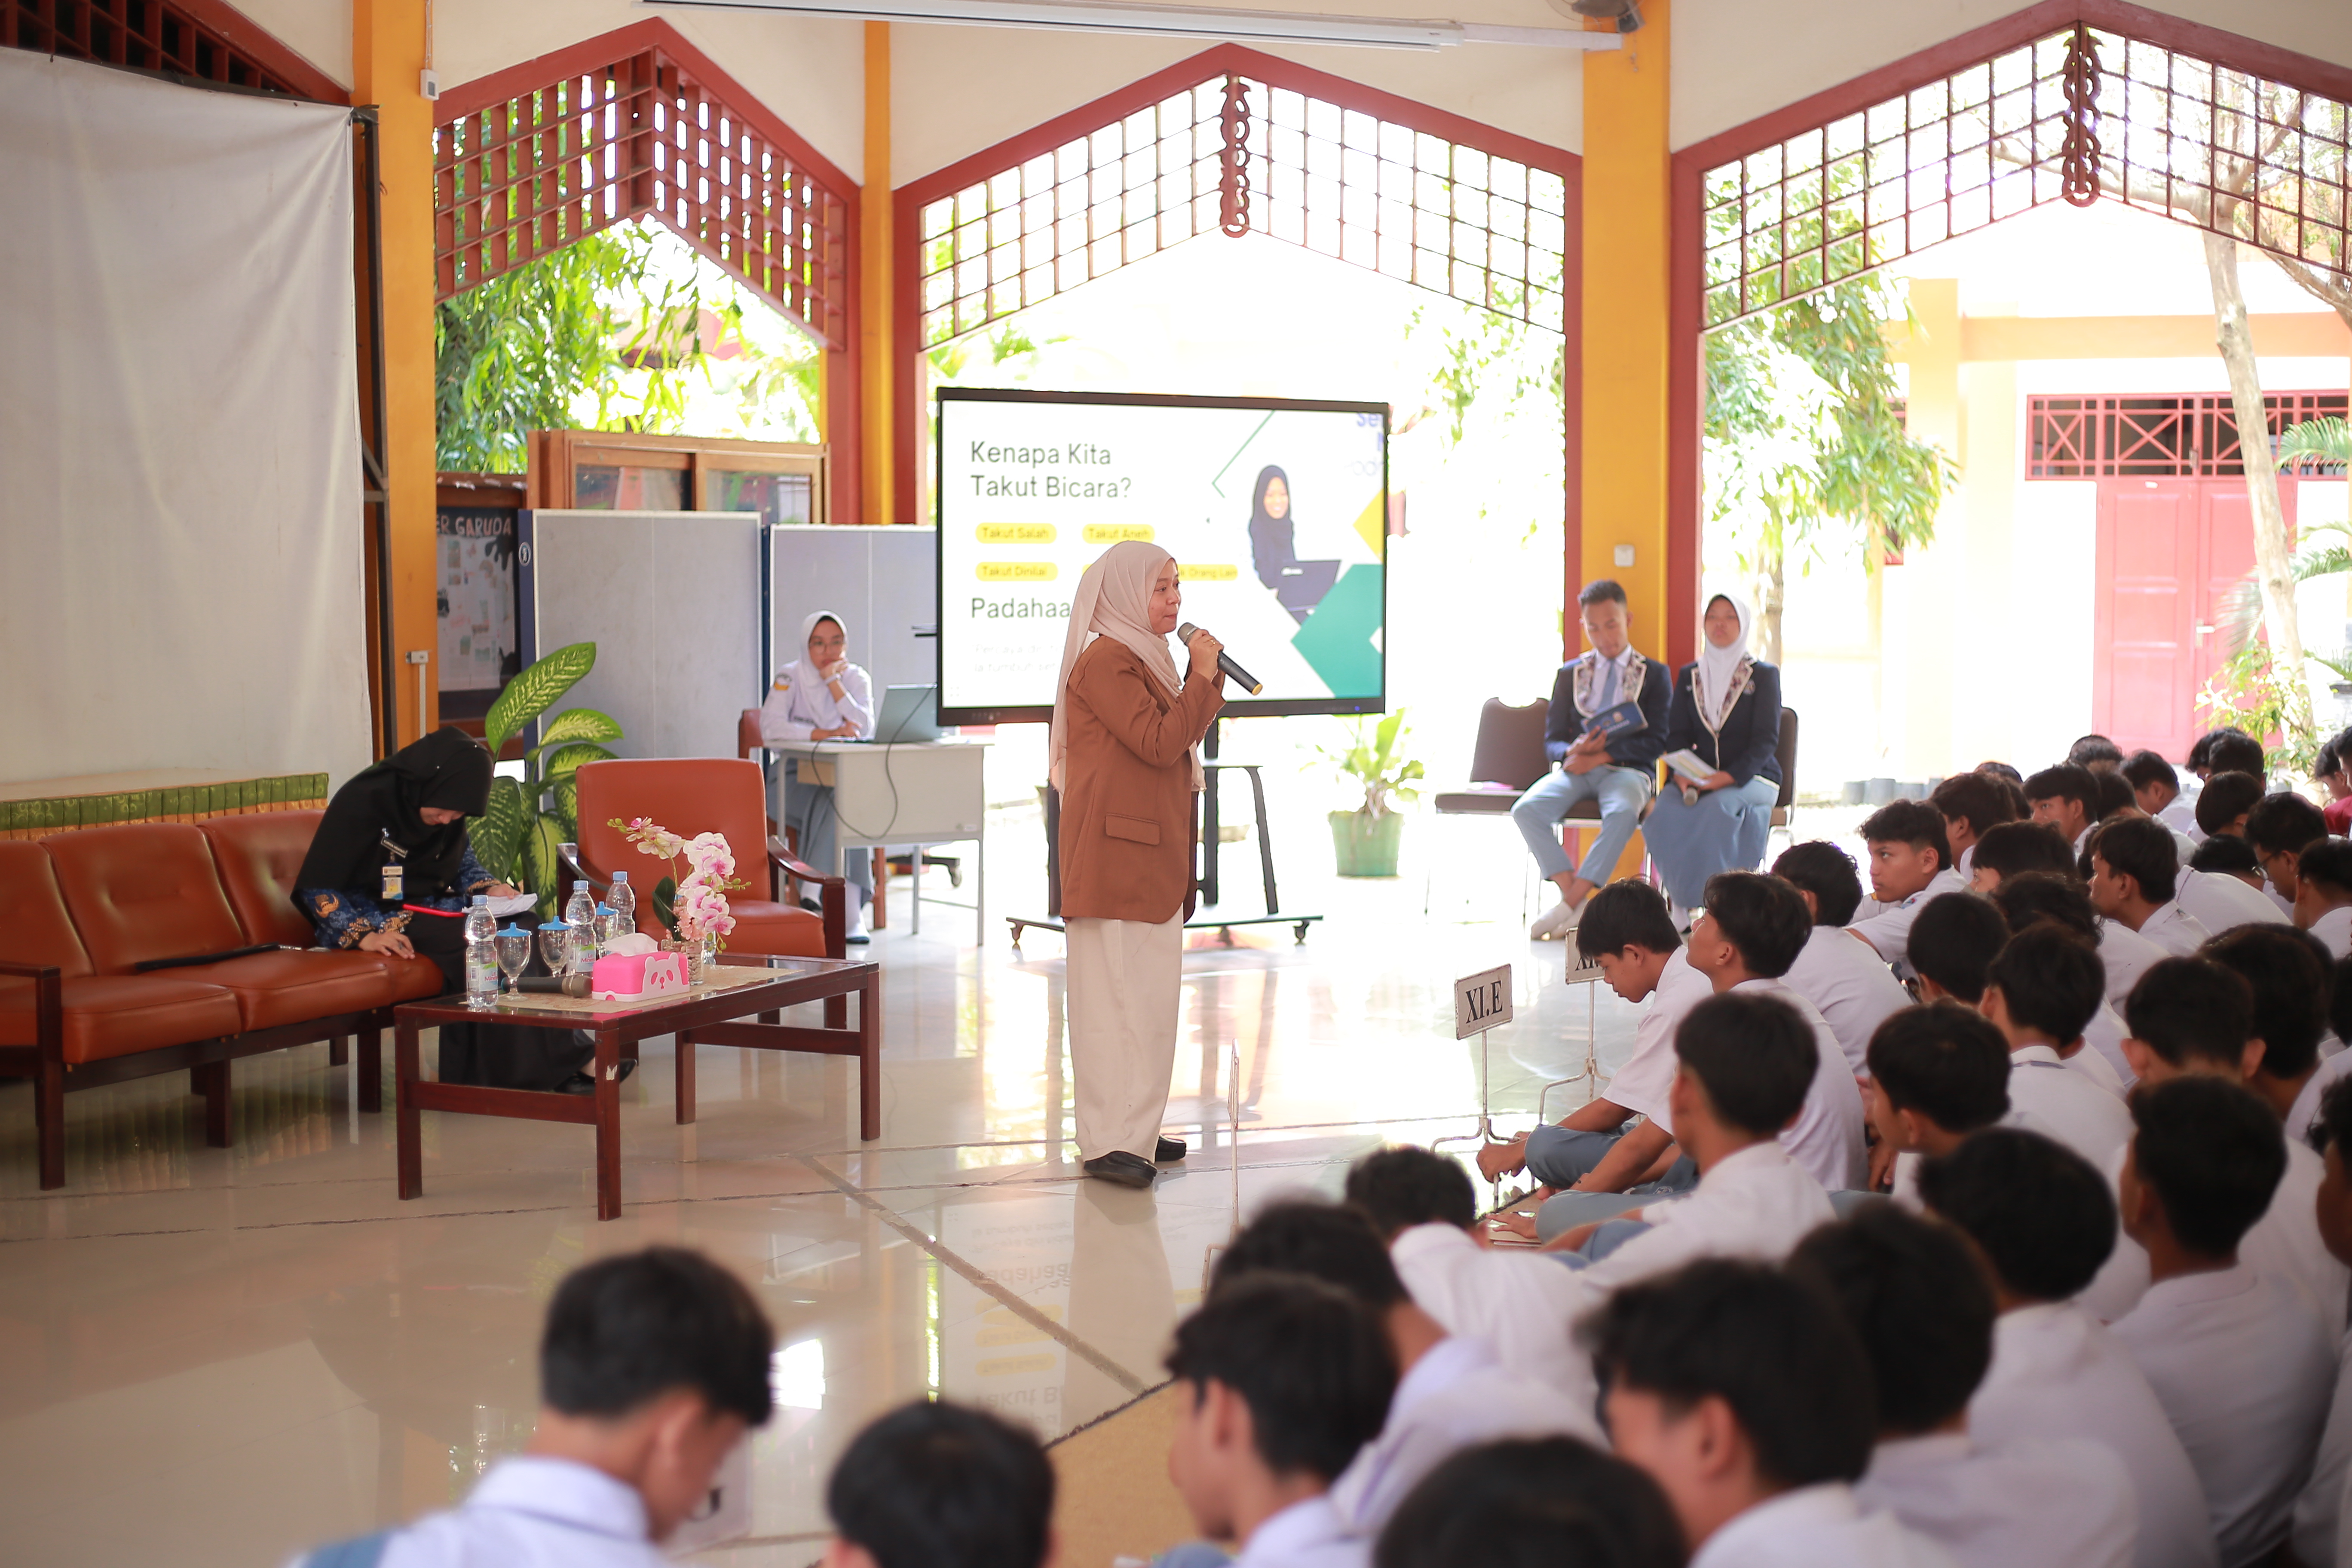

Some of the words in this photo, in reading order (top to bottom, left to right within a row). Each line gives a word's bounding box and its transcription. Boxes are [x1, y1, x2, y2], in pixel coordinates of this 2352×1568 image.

[971, 441, 1060, 469] Kenapa
[1068, 443, 1111, 465] Kita
[970, 475, 1038, 496] Takut
[1046, 476, 1132, 498] Bicara?
[455, 516, 512, 537] GARUDA
[982, 527, 1014, 538] Takut
[1017, 527, 1049, 538] Salah
[1089, 528, 1118, 539] Takut
[982, 566, 1012, 576] Takut
[1466, 980, 1503, 1024] XI.E
